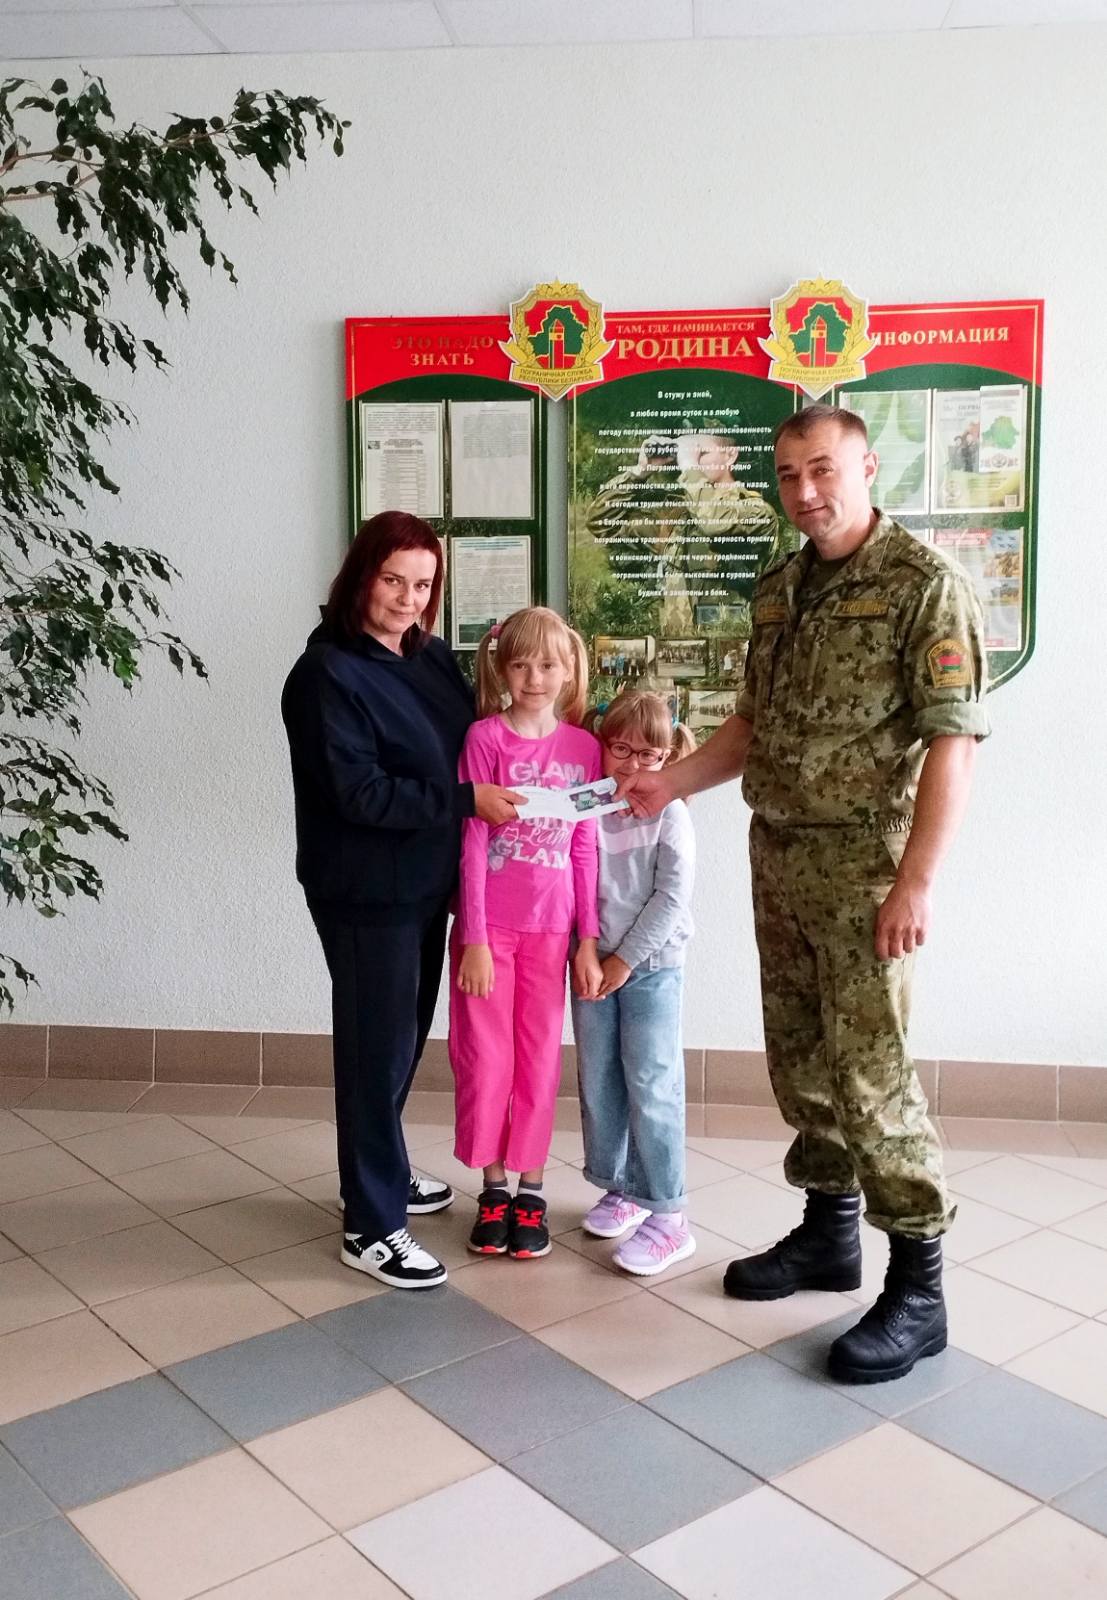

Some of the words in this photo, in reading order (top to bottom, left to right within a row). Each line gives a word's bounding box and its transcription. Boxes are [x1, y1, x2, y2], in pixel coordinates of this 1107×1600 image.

[616, 324, 645, 335] ТАМ,
[649, 323, 670, 335] ГДЕ
[672, 321, 755, 333] НАЧИНАЕТСЯ
[871, 326, 1009, 346] ИНФОРМАЦИЯ
[616, 336, 755, 363] РОДИНА
[410, 353, 474, 366] ЗНАТЬ
[682, 410, 702, 418] суток
[715, 408, 740, 417] любую
[598, 429, 622, 437] погоду
[595, 447, 656, 455] государственого
[508, 760, 585, 784] GLAM
